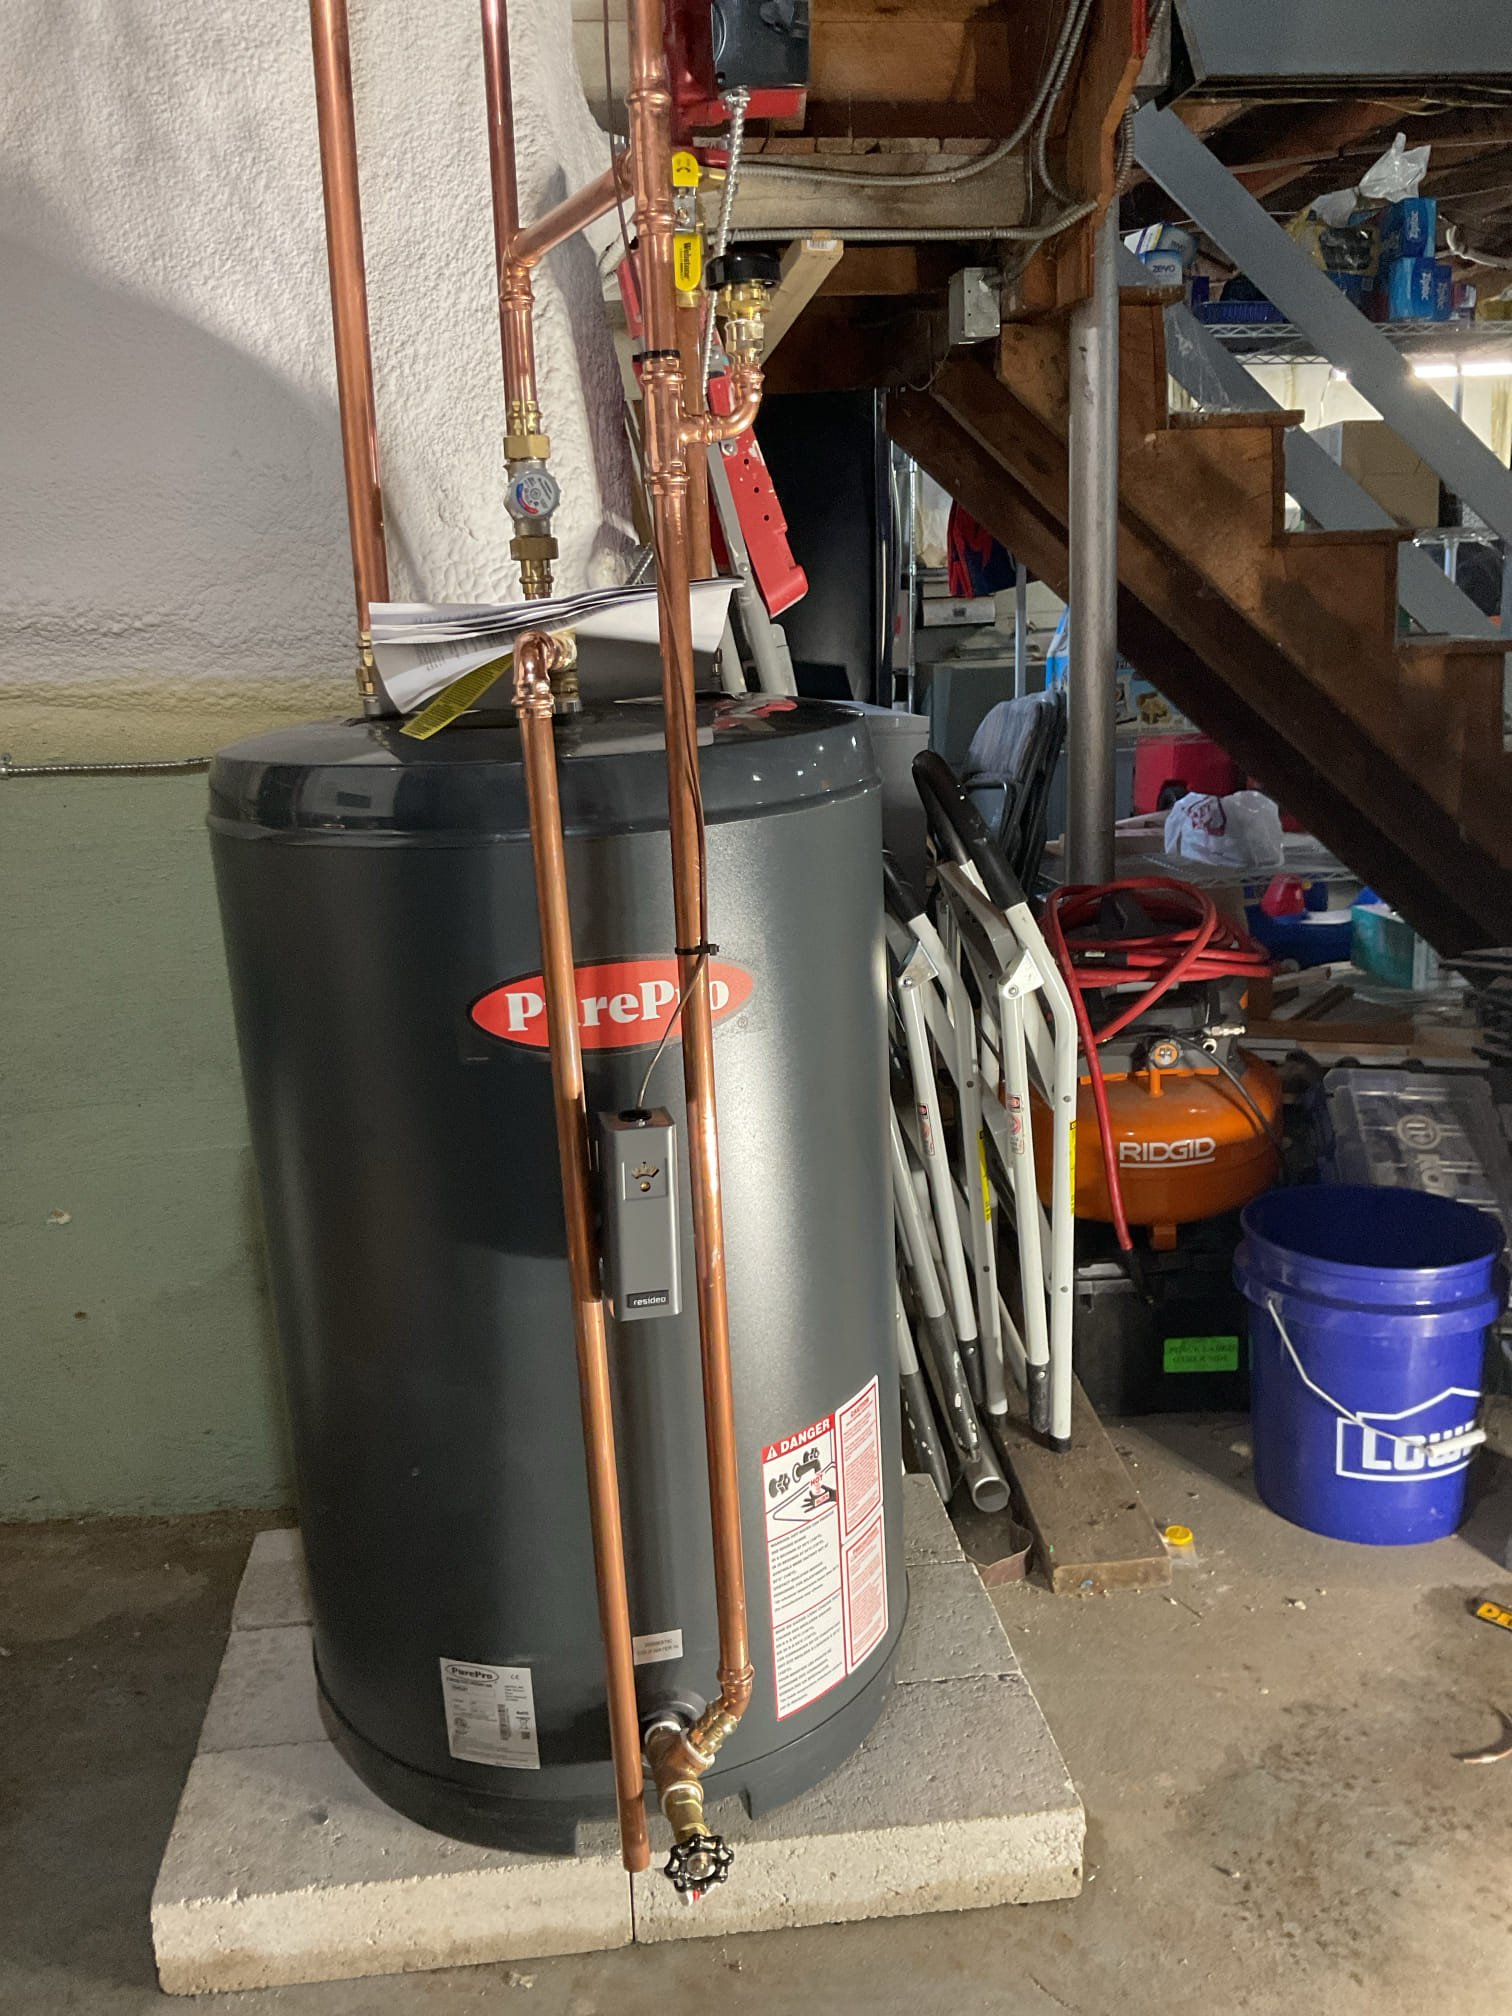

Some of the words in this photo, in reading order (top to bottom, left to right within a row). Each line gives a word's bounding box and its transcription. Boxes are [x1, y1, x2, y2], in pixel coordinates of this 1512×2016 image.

[1419, 271, 1432, 301] Ziploc
[505, 980, 730, 1032] PrePo
[1119, 1136, 1216, 1161] RIDGID
[633, 1295, 667, 1306] resideo
[779, 1417, 831, 1453] DANGER
[810, 1474, 823, 1486] HOT
[451, 1667, 493, 1679] PurePro
